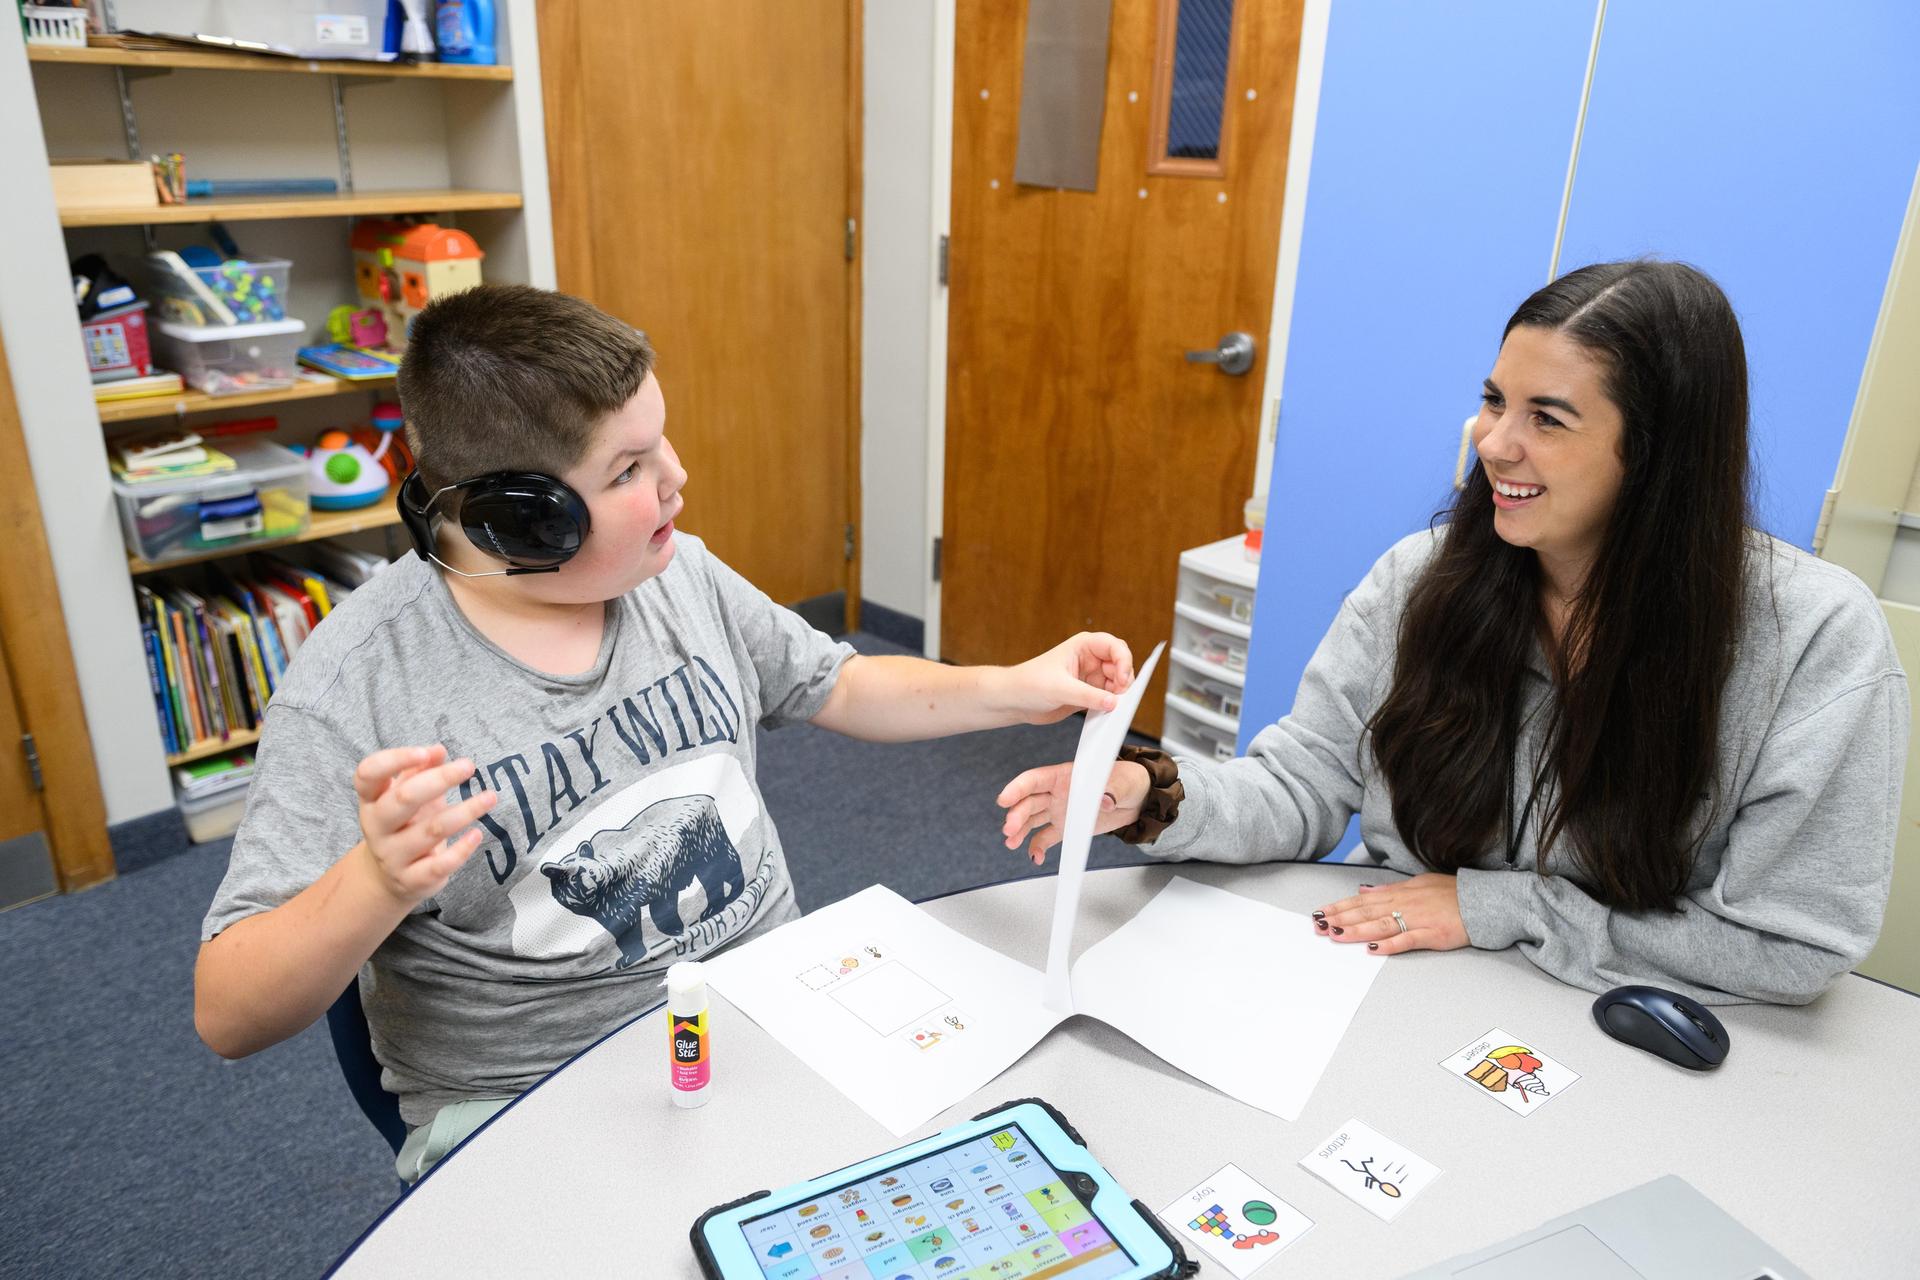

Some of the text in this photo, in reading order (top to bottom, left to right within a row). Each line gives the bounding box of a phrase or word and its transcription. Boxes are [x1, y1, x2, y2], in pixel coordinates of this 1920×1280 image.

[459, 655, 740, 885] STAY WILD
[675, 1039, 698, 1049] Glue
[678, 1048, 697, 1057] Stic
[1461, 1041, 1490, 1061] dessert
[1318, 1132, 1351, 1159] actions
[1192, 1186, 1216, 1202] toys
